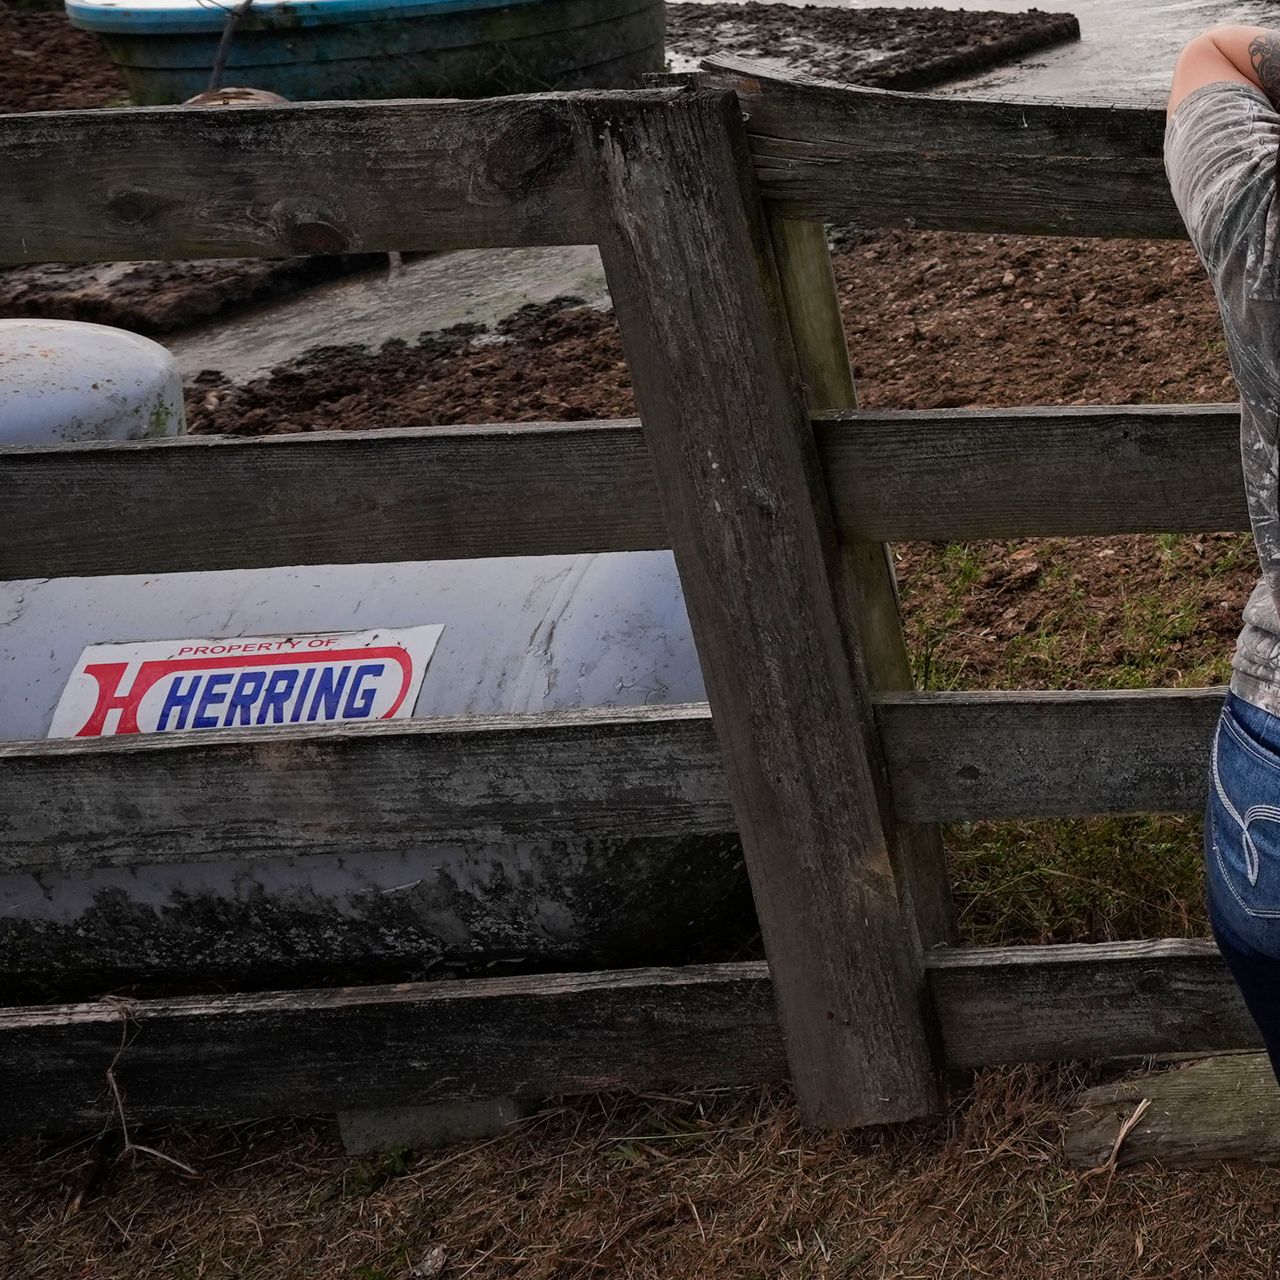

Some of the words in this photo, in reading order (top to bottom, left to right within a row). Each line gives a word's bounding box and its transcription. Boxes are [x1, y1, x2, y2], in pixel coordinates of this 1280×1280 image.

[178, 639, 302, 656] PROPERTY
[307, 638, 340, 649] OF
[156, 664, 386, 732] HERRING
